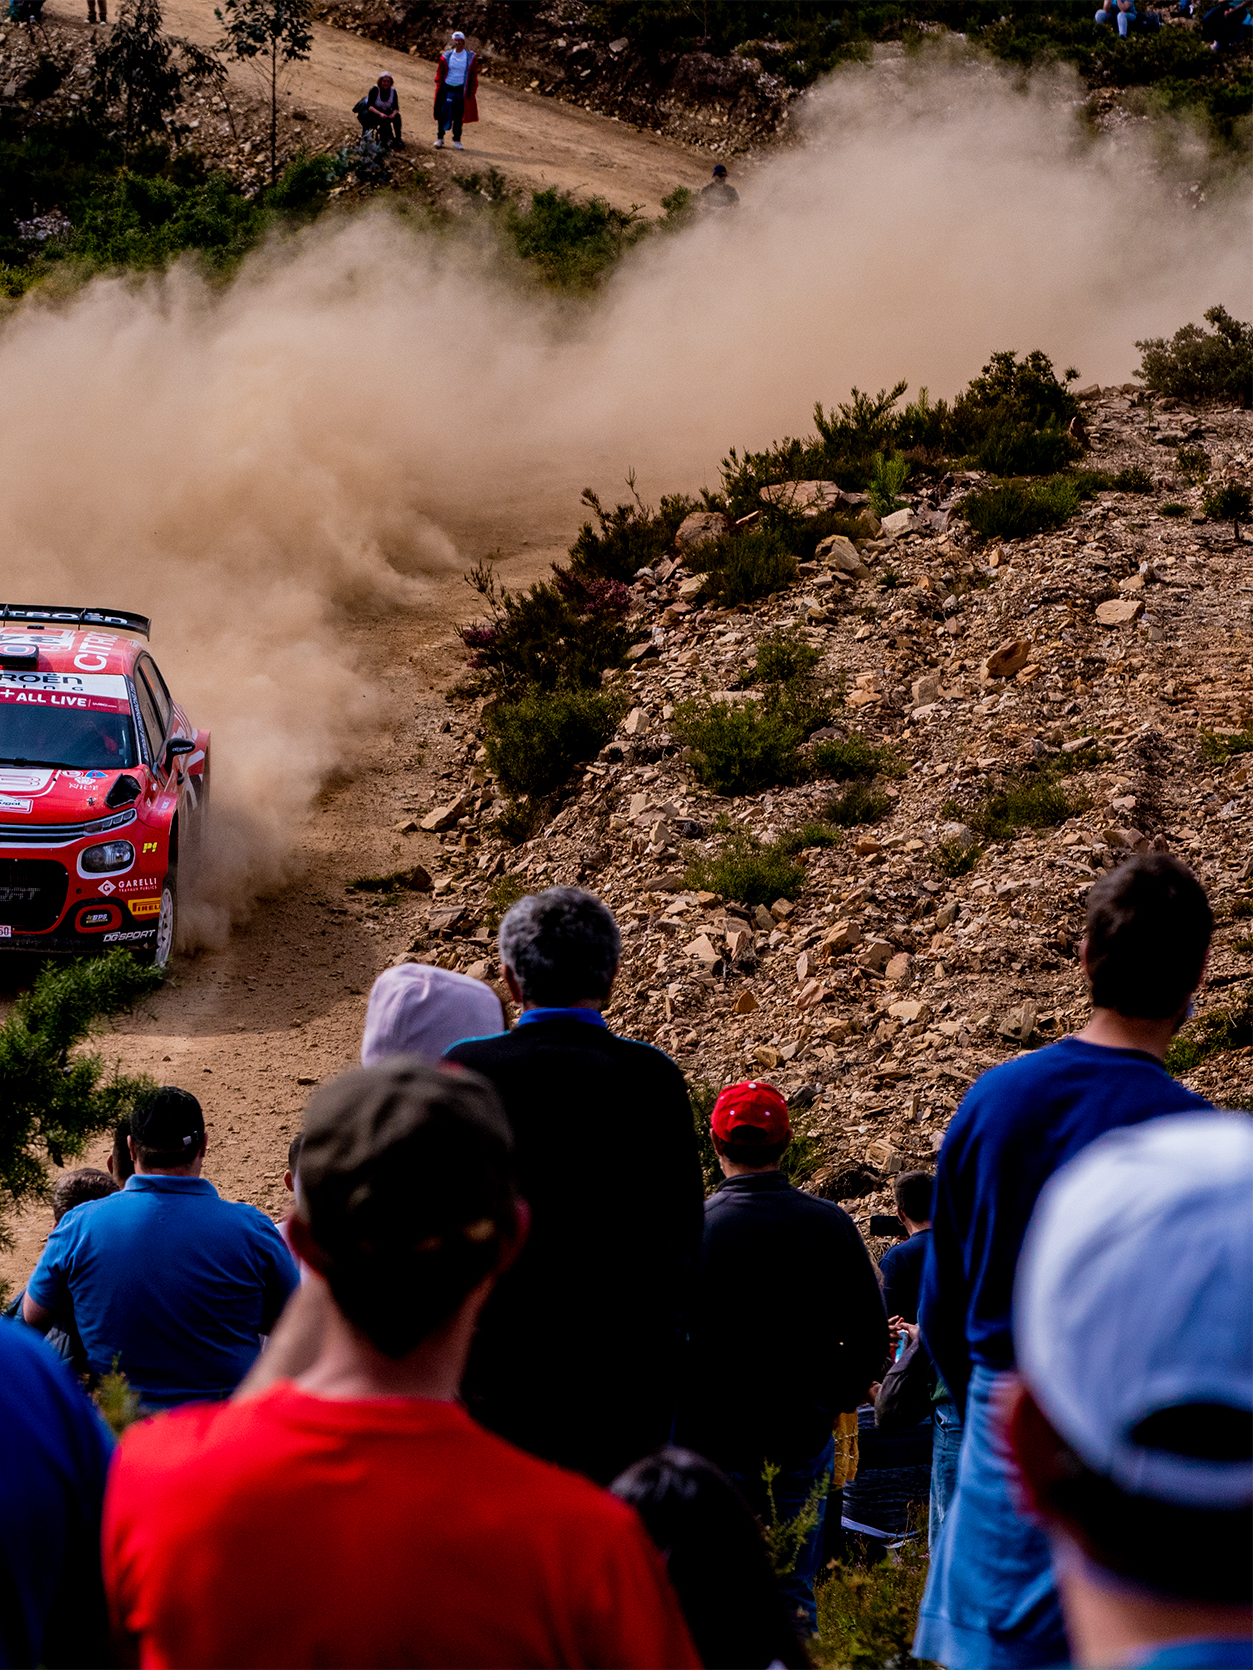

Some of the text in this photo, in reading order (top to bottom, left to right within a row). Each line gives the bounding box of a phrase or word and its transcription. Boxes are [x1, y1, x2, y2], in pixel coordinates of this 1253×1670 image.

[16, 692, 47, 703] ALL
[50, 695, 88, 706] LIVE
[118, 877, 157, 888] GARELLI
